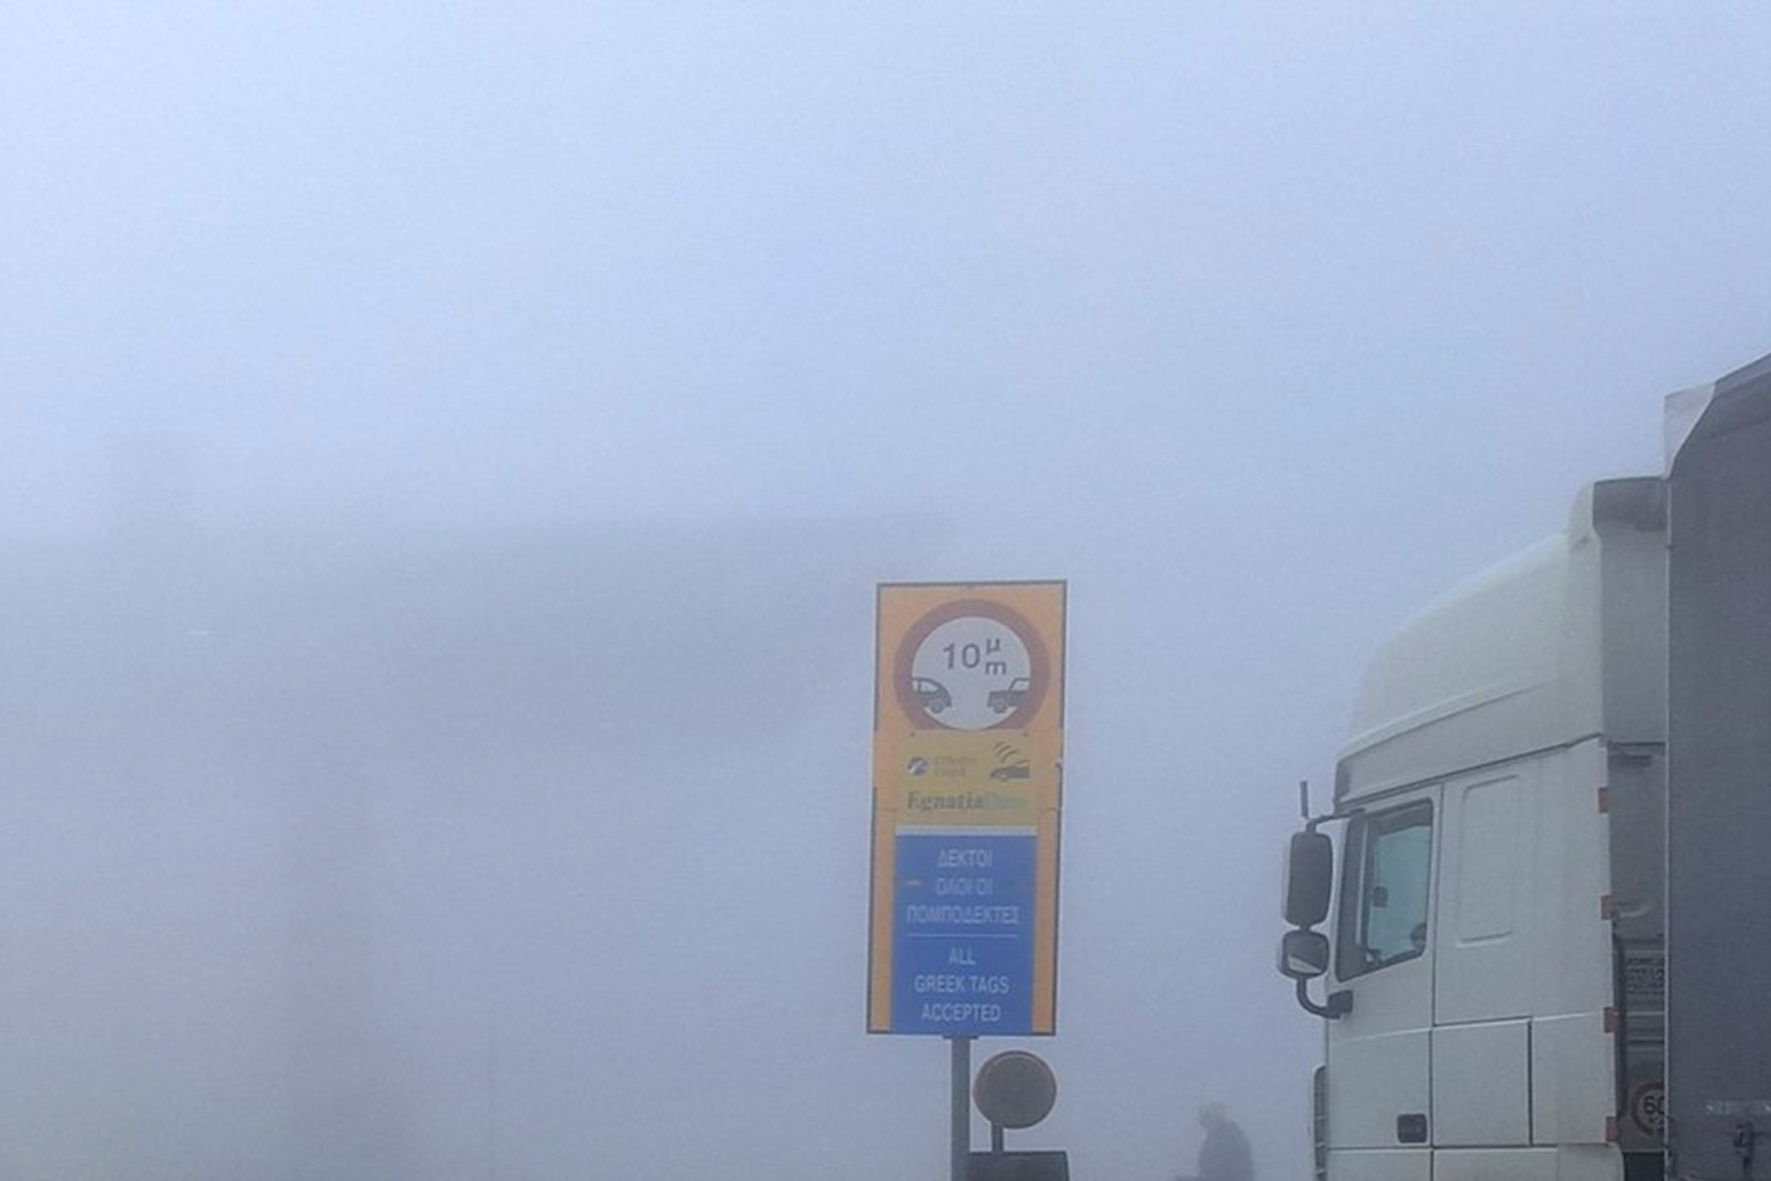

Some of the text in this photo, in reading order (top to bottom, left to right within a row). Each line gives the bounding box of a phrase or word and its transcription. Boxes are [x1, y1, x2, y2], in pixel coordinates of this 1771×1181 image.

[943, 643, 980, 669] 10
[949, 948, 975, 965] ALL
[915, 975, 1009, 994] GREEK TAGS
[922, 1004, 1001, 1022] ACCEPTED
